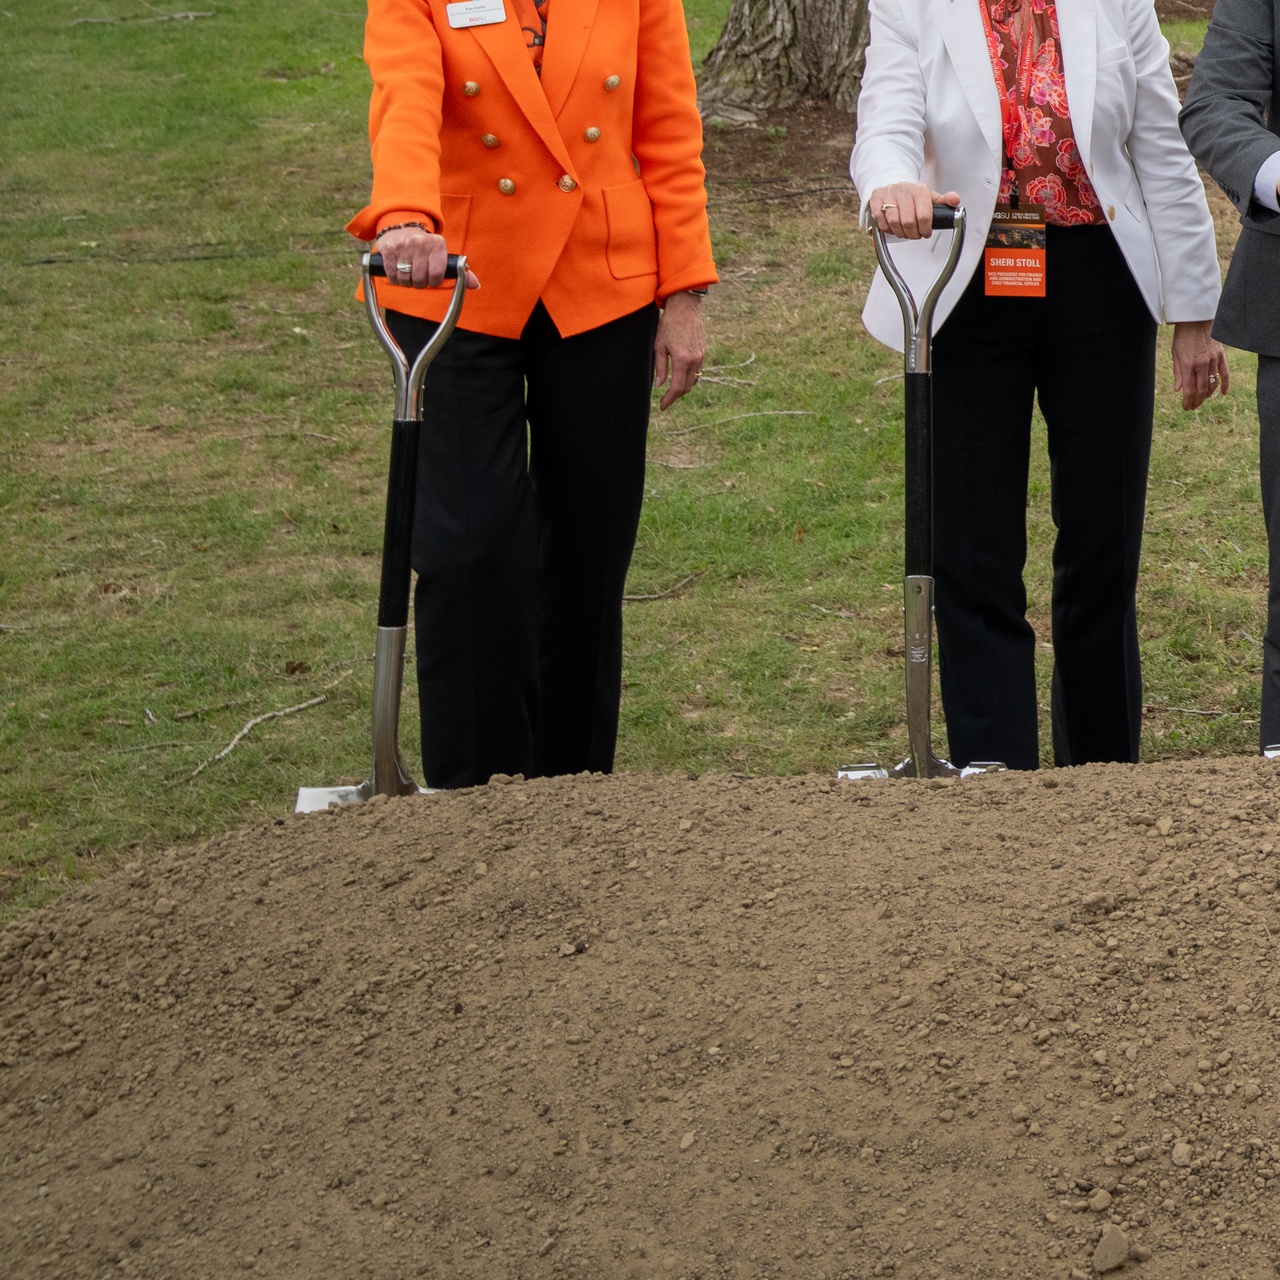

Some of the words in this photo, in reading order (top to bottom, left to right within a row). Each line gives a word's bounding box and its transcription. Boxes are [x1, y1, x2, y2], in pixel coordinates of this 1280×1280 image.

[1022, 35, 1034, 70] University
[1020, 70, 1029, 93] Public
[990, 258, 1014, 266] SHERI
[1016, 259, 1041, 267] STOLL
